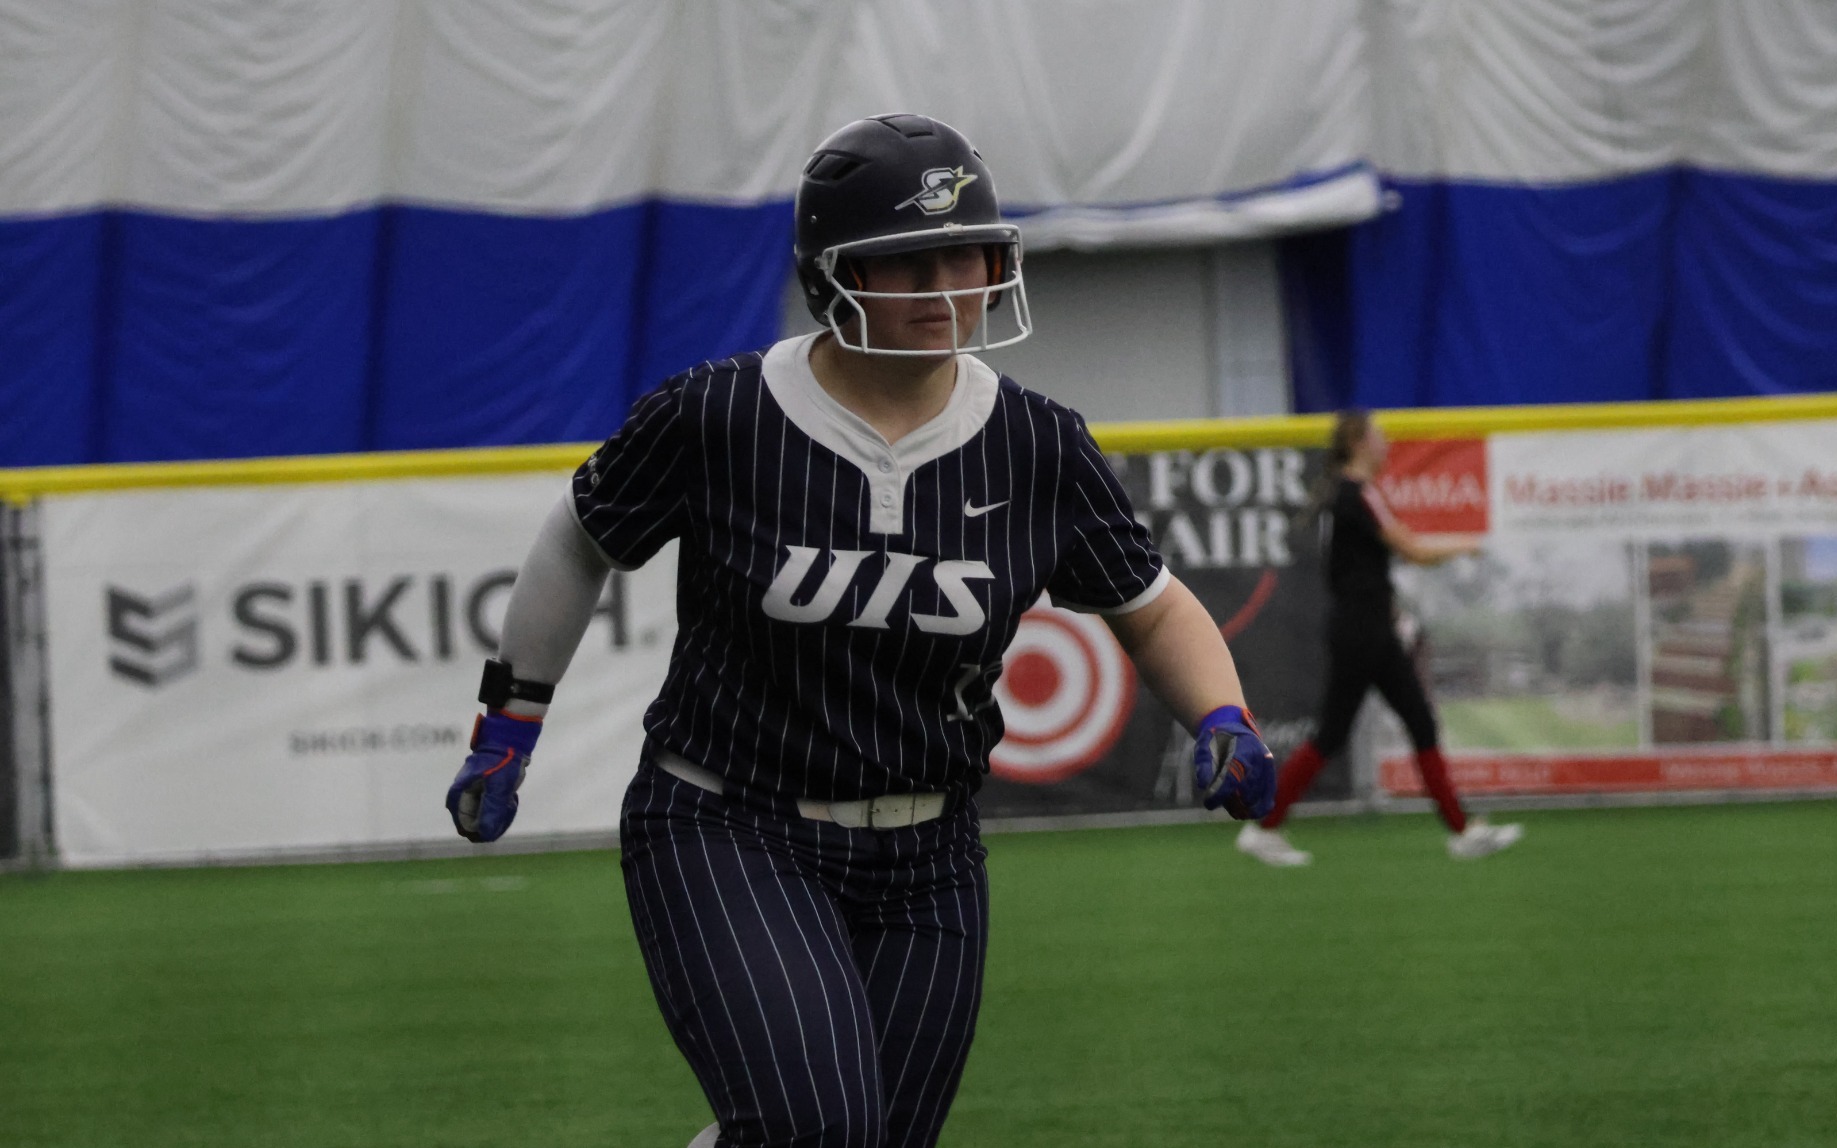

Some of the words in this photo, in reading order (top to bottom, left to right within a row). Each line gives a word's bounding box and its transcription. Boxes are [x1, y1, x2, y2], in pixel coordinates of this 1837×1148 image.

[1150, 448, 1308, 507] FOR
[1133, 509, 1292, 570] AIR
[761, 545, 996, 636] UIS
